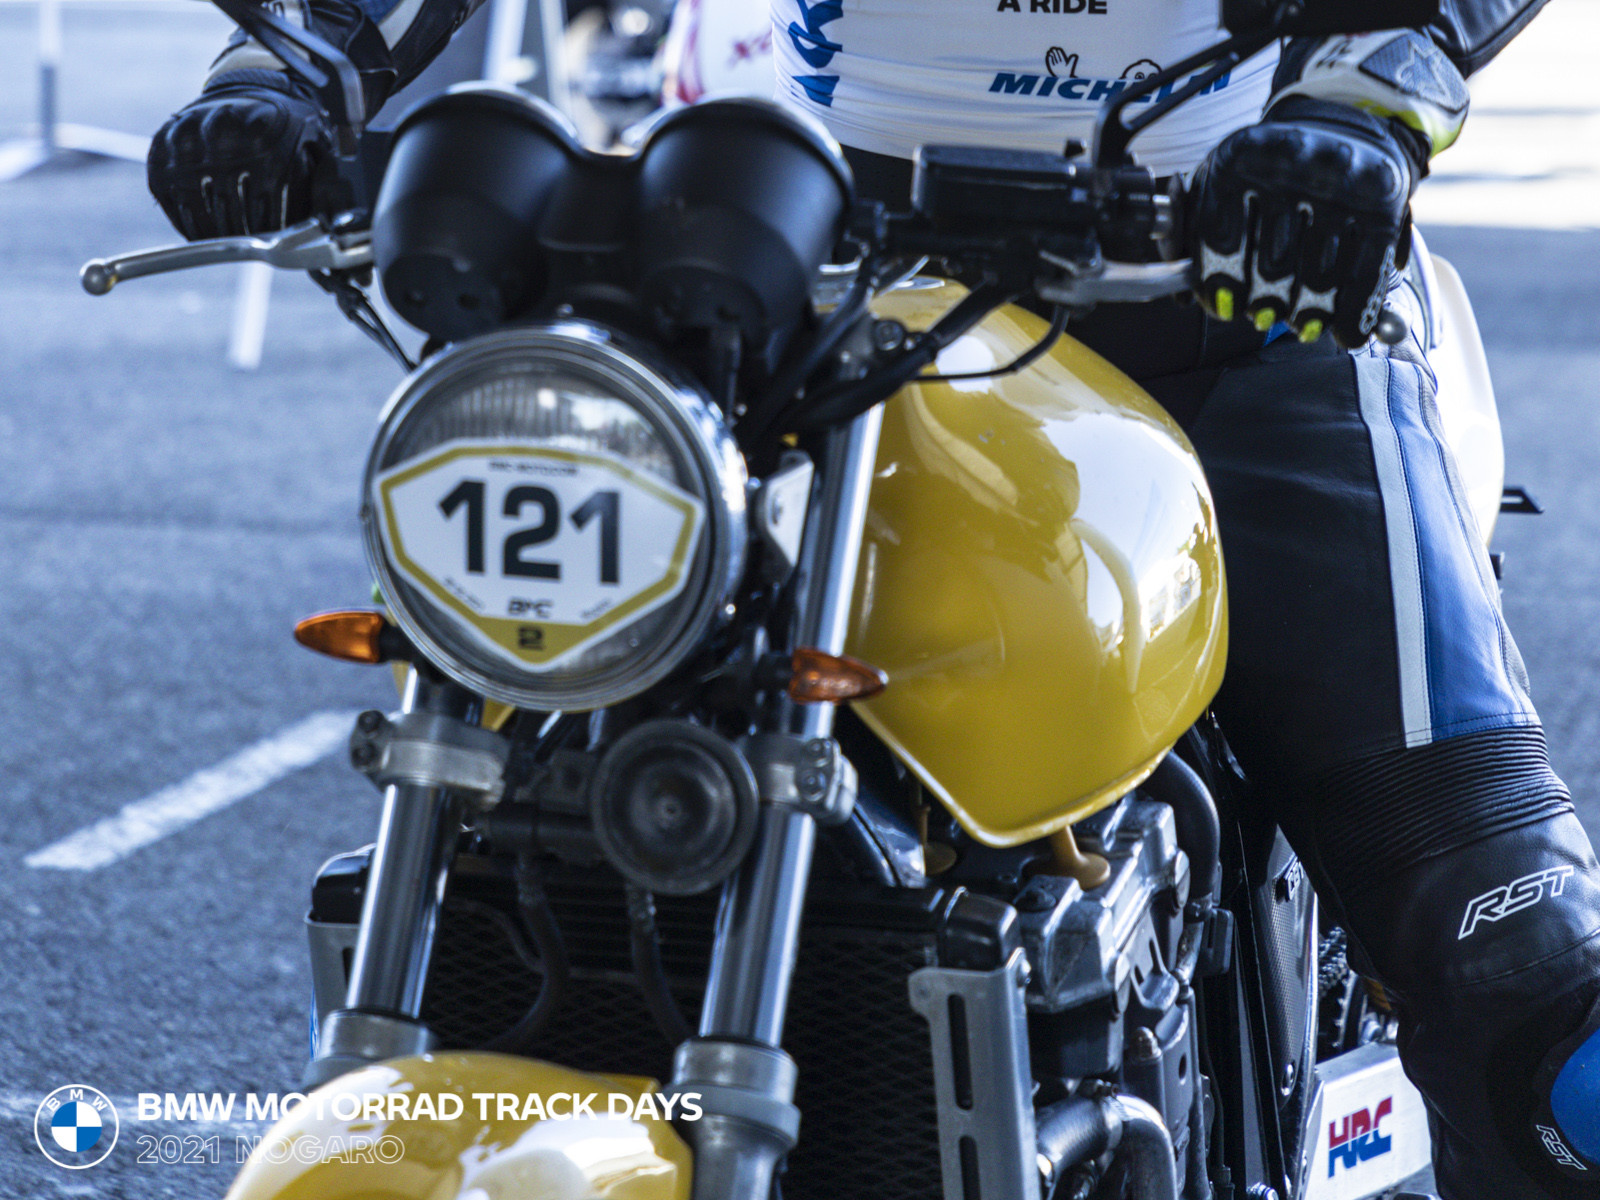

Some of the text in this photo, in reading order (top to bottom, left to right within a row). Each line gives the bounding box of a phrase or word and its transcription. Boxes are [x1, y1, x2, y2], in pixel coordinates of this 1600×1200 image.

[438, 480, 620, 586] 121
[1458, 865, 1574, 940] RST
[1328, 1096, 1393, 1178] HRC
[1535, 1124, 1588, 1171] RST
